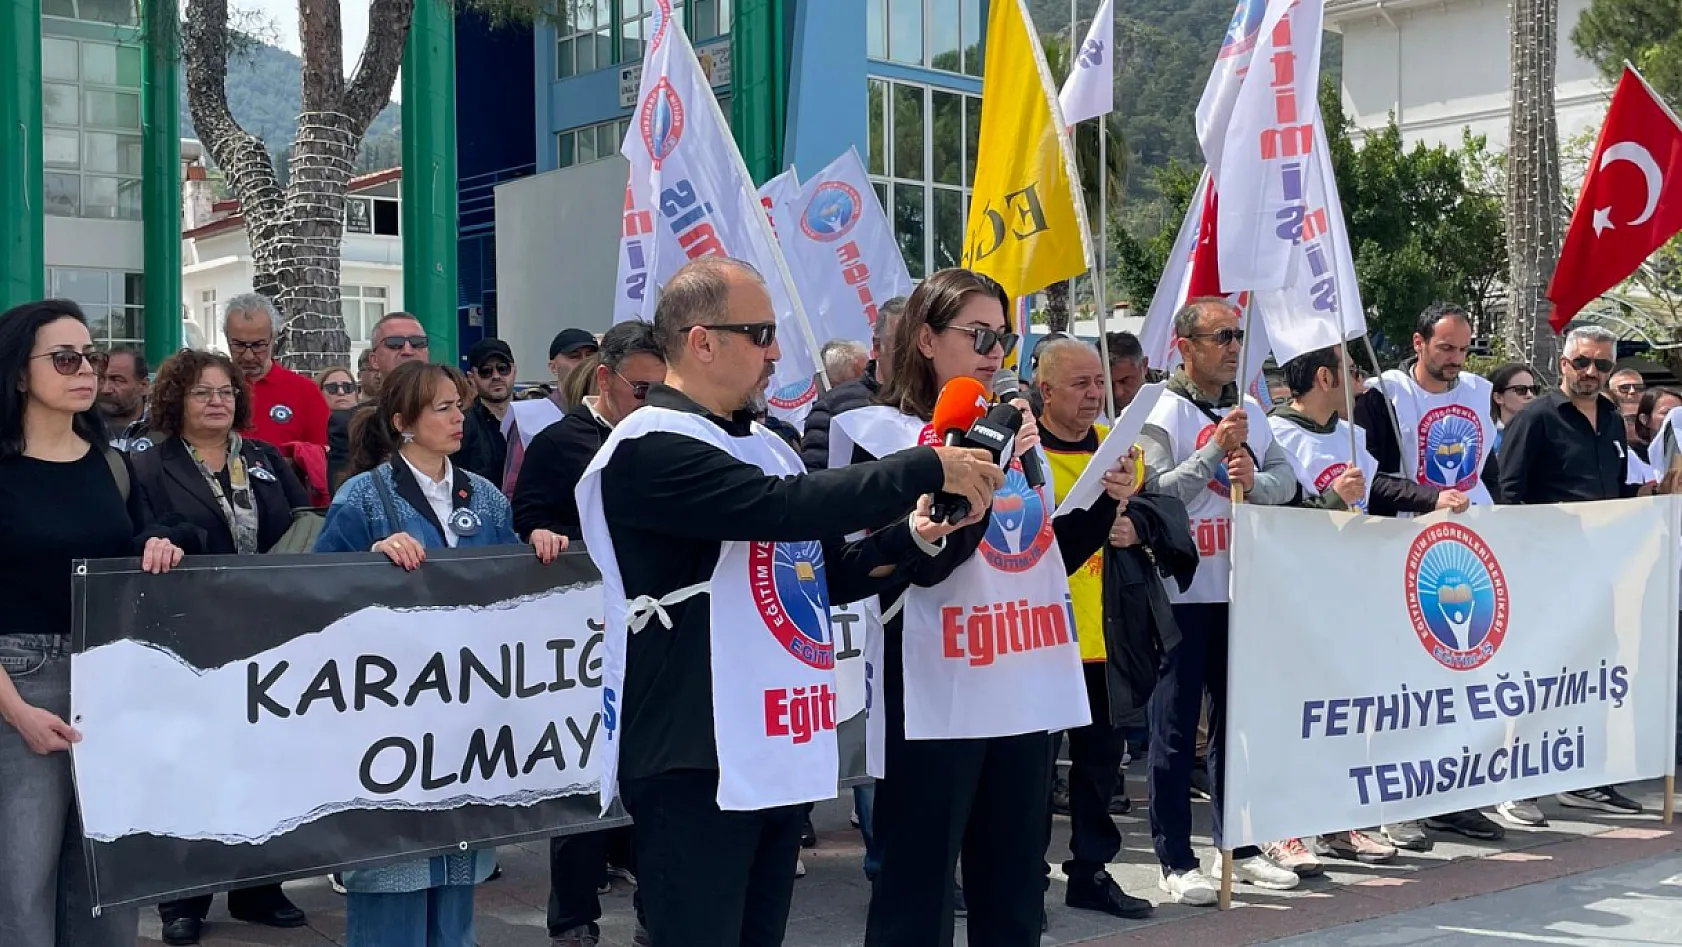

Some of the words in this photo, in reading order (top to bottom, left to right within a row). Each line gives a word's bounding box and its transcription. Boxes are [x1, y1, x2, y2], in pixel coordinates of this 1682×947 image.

[755, 565, 784, 627] EĞİTİM
[1301, 682, 1456, 739] FETHİYE
[1465, 658, 1629, 721] EĞİTİM-İŞ
[1349, 726, 1586, 805] TEMSİLCİLİĞİ
